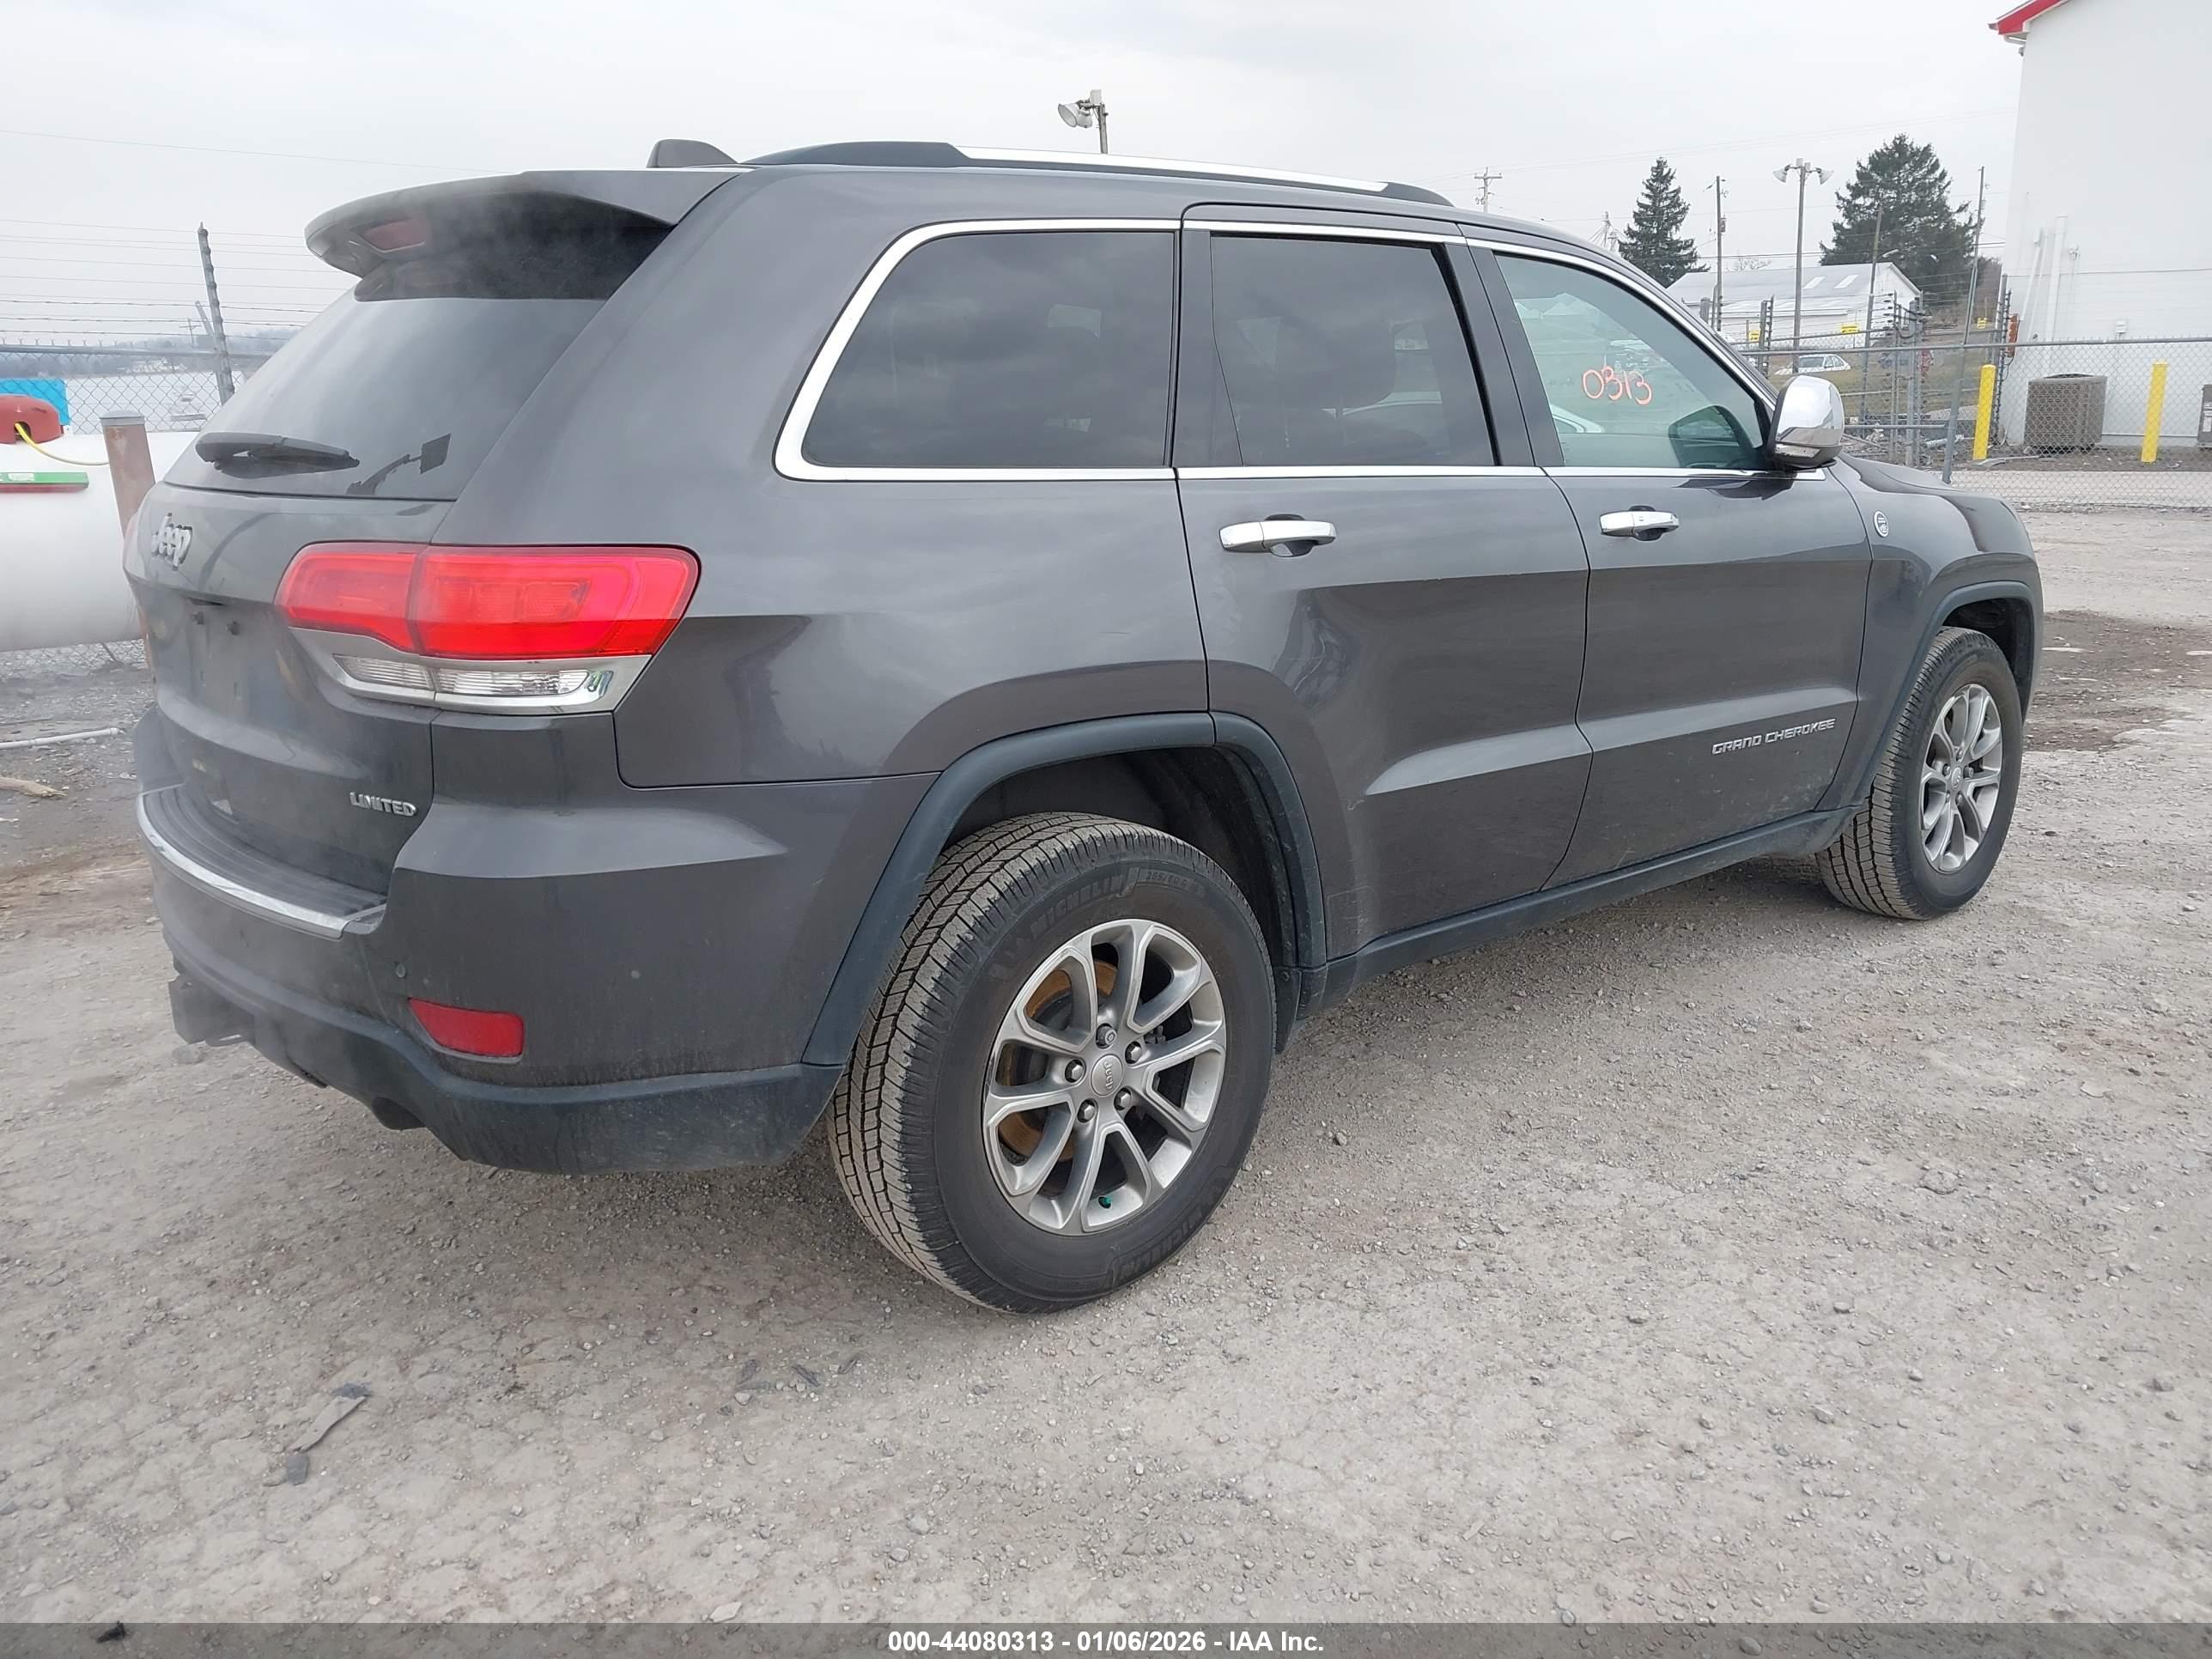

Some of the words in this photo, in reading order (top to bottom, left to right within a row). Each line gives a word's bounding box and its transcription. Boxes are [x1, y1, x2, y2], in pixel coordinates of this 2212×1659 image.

[1583, 365, 1652, 404] 0313
[151, 514, 192, 570] Jeep
[1711, 735, 1762, 755] GRAND
[1765, 718, 1836, 744] CHEROKEE
[349, 792, 416, 817] LIMITED
[1030, 873, 1125, 941] MICHELIN
